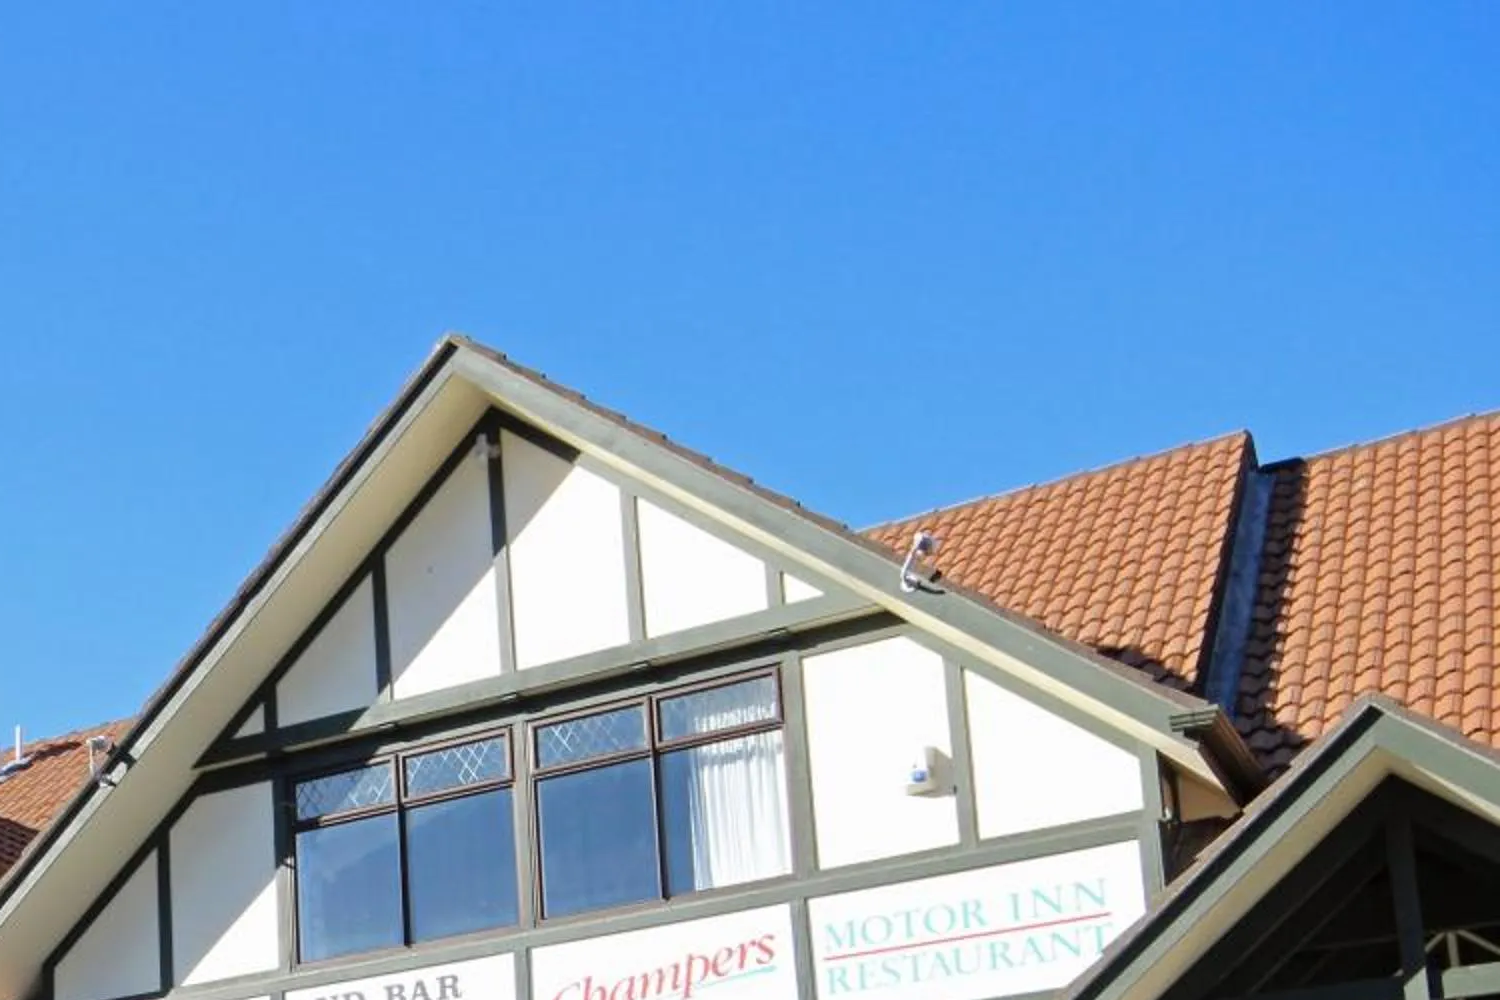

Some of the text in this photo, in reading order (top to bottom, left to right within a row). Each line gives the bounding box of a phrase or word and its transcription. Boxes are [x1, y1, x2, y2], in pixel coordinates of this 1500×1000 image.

[825, 879, 1106, 953] MOTOR INN
[827, 922, 1114, 996] RESTAURANT
